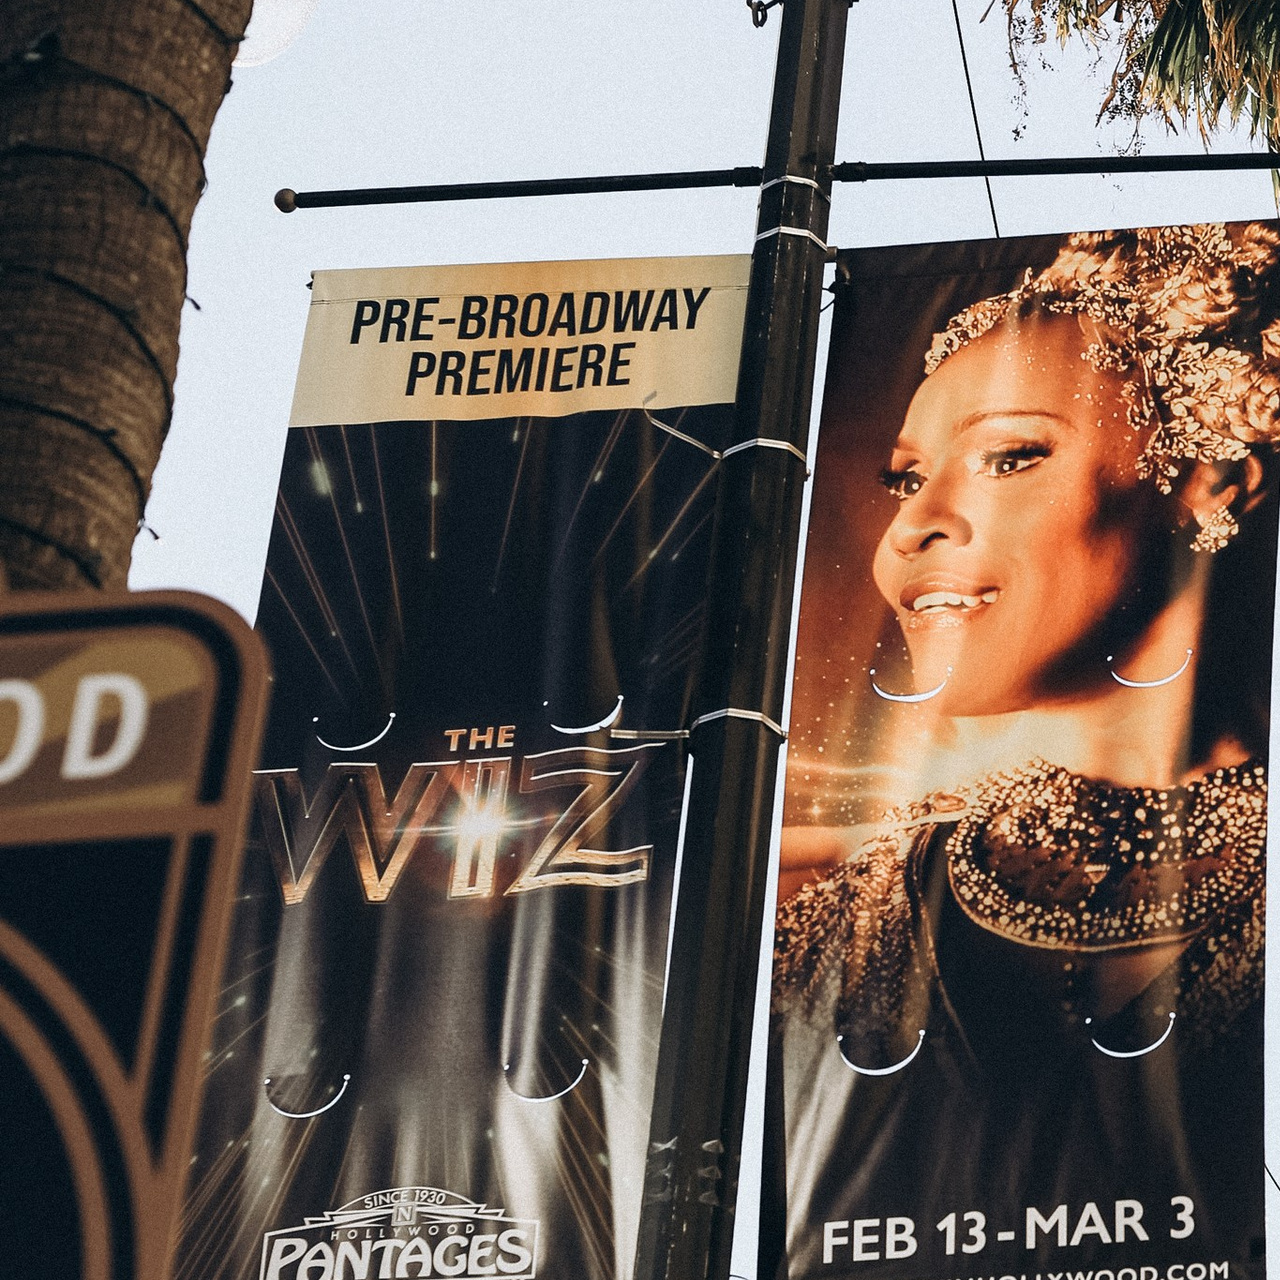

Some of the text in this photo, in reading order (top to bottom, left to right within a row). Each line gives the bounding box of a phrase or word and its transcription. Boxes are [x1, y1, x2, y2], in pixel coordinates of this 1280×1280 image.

[350, 287, 712, 345] PRE-BROADWAY
[405, 341, 637, 397] PREMIERE
[444, 724, 517, 753] THE
[250, 741, 667, 906] WIZ
[364, 1188, 446, 1209] SINCE 1930
[330, 1223, 475, 1241] HOLLYWOOD
[821, 1216, 919, 1264] FEB
[1169, 1194, 1197, 1239] 3
